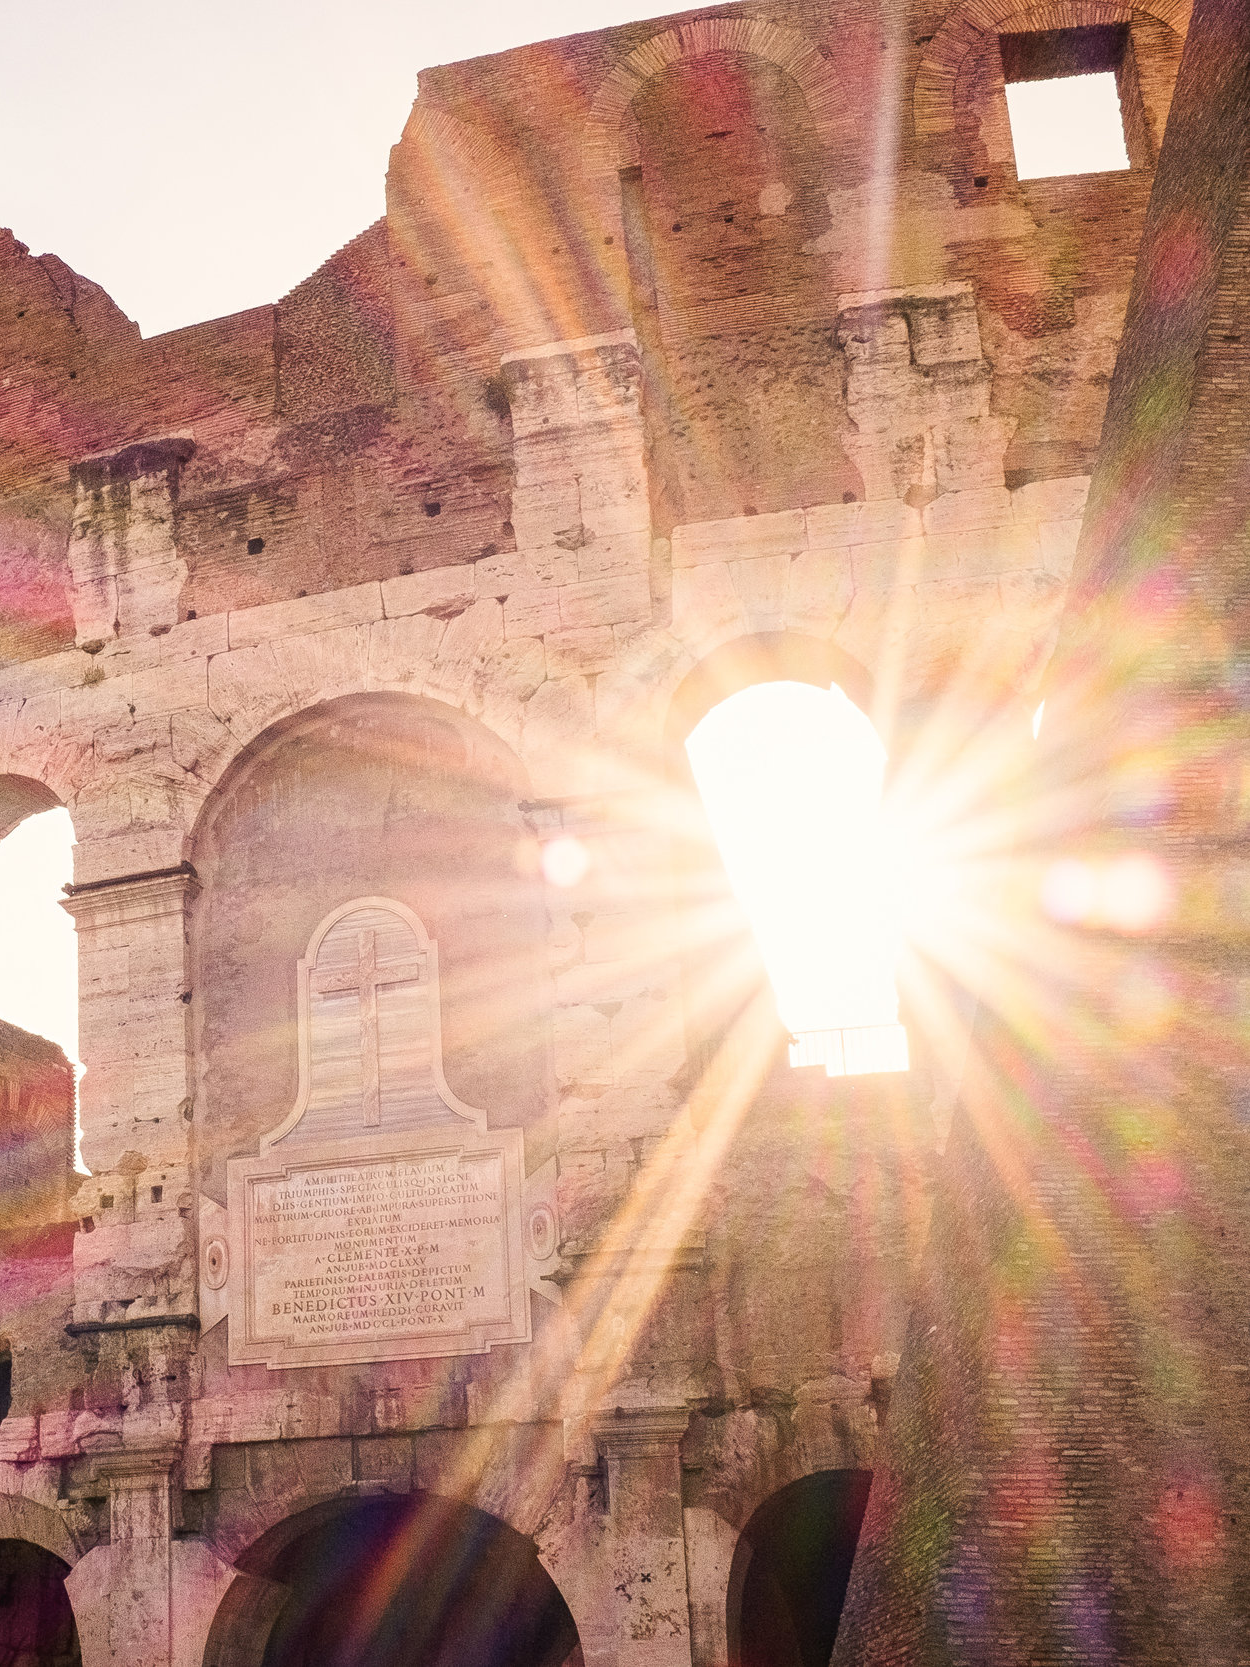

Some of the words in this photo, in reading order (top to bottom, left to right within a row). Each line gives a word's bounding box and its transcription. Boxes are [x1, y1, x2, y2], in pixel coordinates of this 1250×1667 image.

[279, 1187, 338, 1200] TRIUMPHIS
[423, 1172, 470, 1185] INSIGNE
[304, 1170, 393, 1187] AMPHITHEATRUM
[398, 1163, 445, 1177] FLAVIUM
[300, 1196, 349, 1208] GENTIUM
[352, 1192, 384, 1204] IMPIO
[389, 1188, 426, 1199] CULTU
[428, 1182, 479, 1196] DICATUM
[255, 1211, 309, 1225] MARTYRUM
[313, 1206, 356, 1219] CRUORE
[358, 1205, 372, 1214] AB
[377, 1200, 417, 1212] IMPURA
[419, 1192, 498, 1208] SUPERSTITIONE
[347, 1214, 402, 1227] EXPIATUM
[255, 1237, 268, 1247] NE
[272, 1230, 345, 1245] FORTITUDINIS
[350, 1226, 387, 1238] EORUM
[390, 1220, 445, 1234] EXCIDERET
[449, 1215, 500, 1228] MEMORIA
[334, 1234, 417, 1251] MONUMENTUM
[327, 1247, 398, 1263] CLEMENTE
[404, 1246, 412, 1256] X
[417, 1244, 424, 1255] P
[430, 1243, 439, 1254] M
[284, 1275, 344, 1289] PARIETINIS
[348, 1269, 407, 1284] DEALBATIS
[412, 1263, 471, 1278] DEPICTUM
[326, 1265, 342, 1274] AN
[344, 1262, 365, 1273] JUB
[293, 1286, 355, 1299] TEMPORUM
[359, 1280, 406, 1293] INJURIA
[410, 1275, 463, 1288] DELETUM
[272, 1294, 377, 1316] BENEDICTUS
[384, 1291, 414, 1306] XIV
[420, 1286, 467, 1302] PONT
[473, 1286, 485, 1298] M
[293, 1309, 369, 1324] MARMOREUM
[373, 1305, 410, 1317] REDDI
[415, 1301, 463, 1314] CURAVIT
[310, 1324, 326, 1334] AN
[328, 1322, 349, 1332] JUB
[401, 1315, 433, 1326] PONT
[437, 1315, 445, 1323] X
